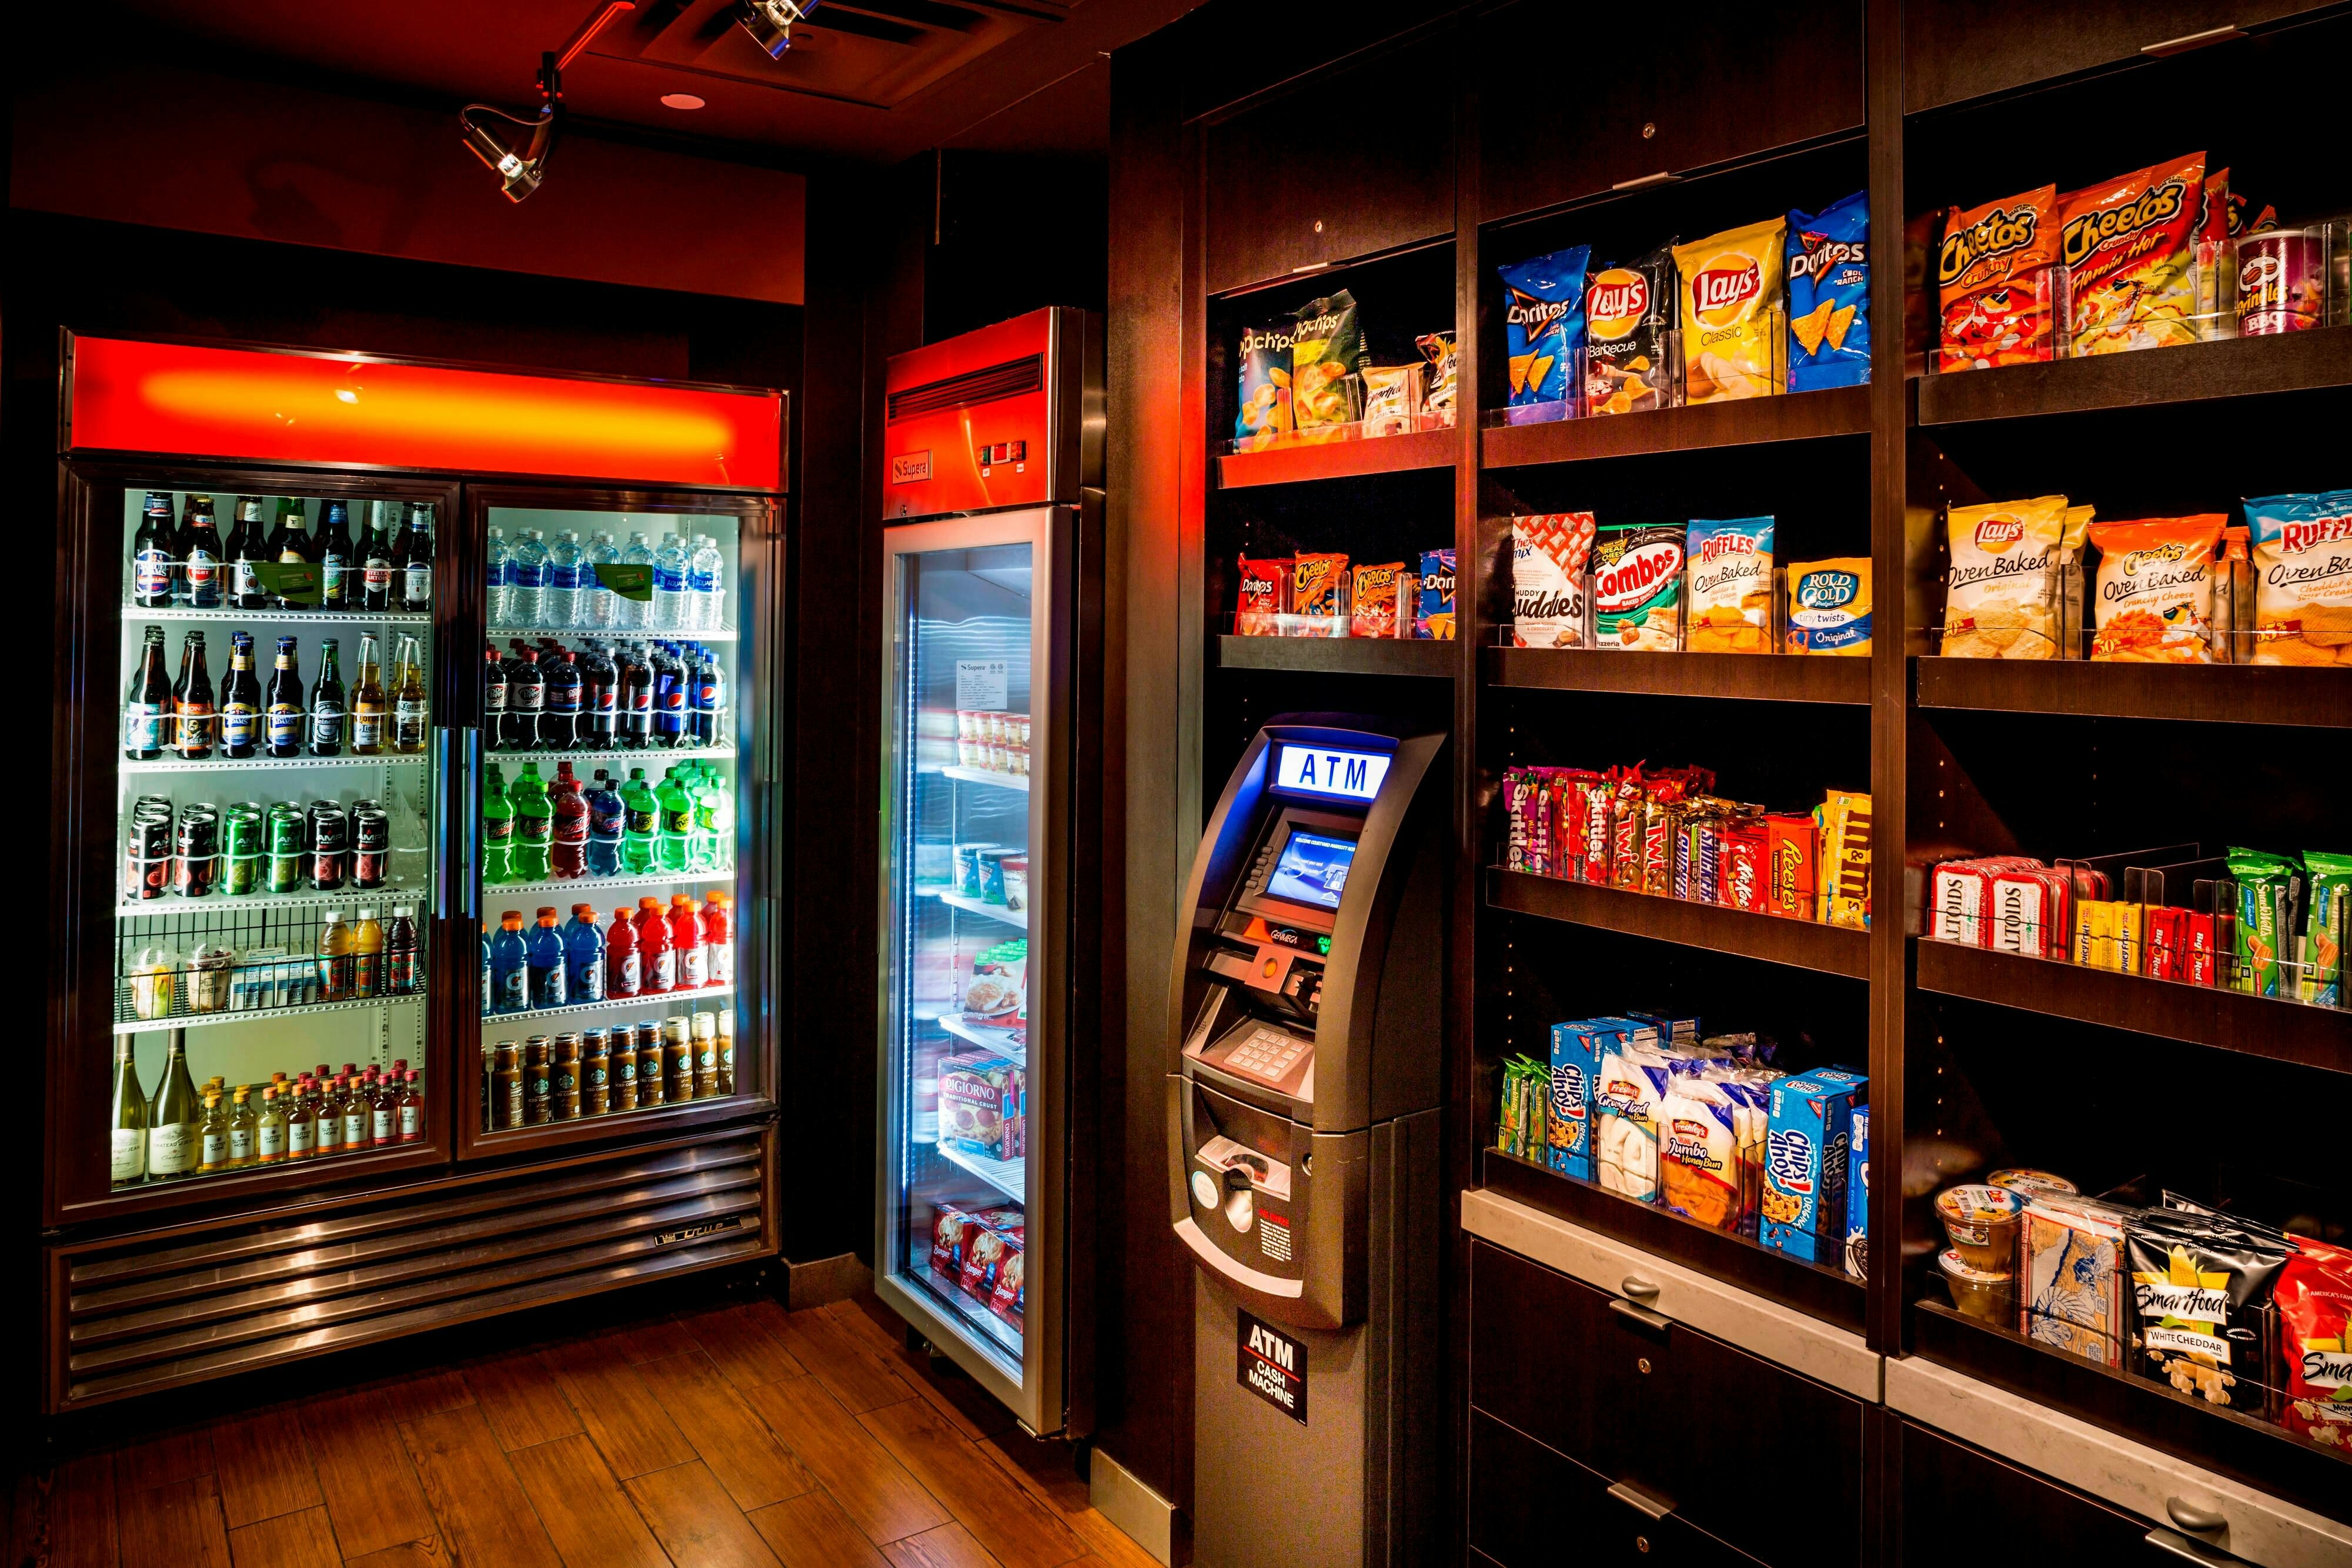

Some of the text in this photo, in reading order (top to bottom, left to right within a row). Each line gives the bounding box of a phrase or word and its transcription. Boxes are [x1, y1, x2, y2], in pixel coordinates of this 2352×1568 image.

[2062, 185, 2181, 267] Cheetos
[1940, 209, 2033, 284] Cheetos
[2099, 229, 2142, 251] Crunchy
[1790, 242, 1865, 279] Doritos
[1961, 255, 2012, 287] Crunchy
[2072, 231, 2166, 292] Flamin' Hot
[1836, 275, 1863, 285] RANCH
[1843, 269, 1862, 278] COOL
[1698, 266, 1756, 312] Lay's
[1507, 299, 1569, 324] Doritos
[1589, 281, 1644, 322] Lay's
[1701, 325, 1742, 346] Classic
[1589, 340, 1636, 357] Barbecue
[903, 461, 927, 479] Supera
[1977, 520, 2022, 543] Lay's
[2282, 516, 2352, 552] RUFFL
[1602, 550, 1626, 561] CHEESE
[1603, 545, 1625, 555] REAL
[1702, 534, 1755, 565] RUFFLES
[2124, 544, 2186, 577] Cheetos
[1994, 550, 2053, 575] Baked
[1242, 579, 1272, 593] Doritos
[1296, 560, 1332, 590] Cheetos
[1358, 569, 1394, 599] Cheetos
[1695, 560, 1762, 592] Oven Baked
[1808, 573, 1852, 589] ROLD
[2147, 565, 2205, 589] Baked
[2269, 564, 2327, 587] Oven
[1801, 586, 1851, 604] GOLD
[2162, 590, 2194, 601] Cheese
[2300, 580, 2344, 593] Cheddar
[1622, 598, 1639, 607] BAKED
[1799, 613, 1845, 624] tiny twists
[1816, 628, 1856, 645] Original
[2097, 637, 2121, 655] 50%
[1299, 753, 1367, 791] ATM
[1509, 783, 1529, 871] Skittles
[1589, 788, 1606, 863] Skittles
[316, 834, 342, 842] AMP
[1782, 838, 1803, 914] Reese's
[1945, 879, 1963, 941] LTOIDS
[2256, 884, 2273, 937] SnackWell's
[1271, 930, 1298, 944] GENMEGA
[2152, 928, 2164, 976] Big Red
[2194, 932, 2204, 981] Big Red
[1563, 1065, 1583, 1108] Chips
[943, 1092, 997, 1109] TRADITIONAL CRUST
[1598, 1094, 1651, 1115] Grand Iced
[1634, 1113, 1649, 1122] Bun
[1675, 1122, 1706, 1137] Freshley's
[1669, 1139, 1708, 1158] Jumbo
[1785, 1130, 1809, 1182] Chips
[1681, 1155, 1722, 1170] Honey Bun
[1989, 1190, 2006, 1203] Dole
[934, 1244, 951, 1259] Banquet
[2115, 1241, 2124, 1251] POP
[965, 1261, 984, 1278] Banquet
[994, 1284, 1015, 1300] Banquet
[2134, 1284, 2229, 1315] Smartfood
[2310, 1290, 2340, 1299] AMERICA'S
[2194, 1313, 2224, 1322] POPCORN
[1249, 1324, 1294, 1372] ATM
[2151, 1331, 2175, 1342] WHITE
[2177, 1334, 2223, 1353] CHEDDAR
[1257, 1360, 1285, 1388] CASH
[1249, 1369, 1294, 1409] MACHINE
